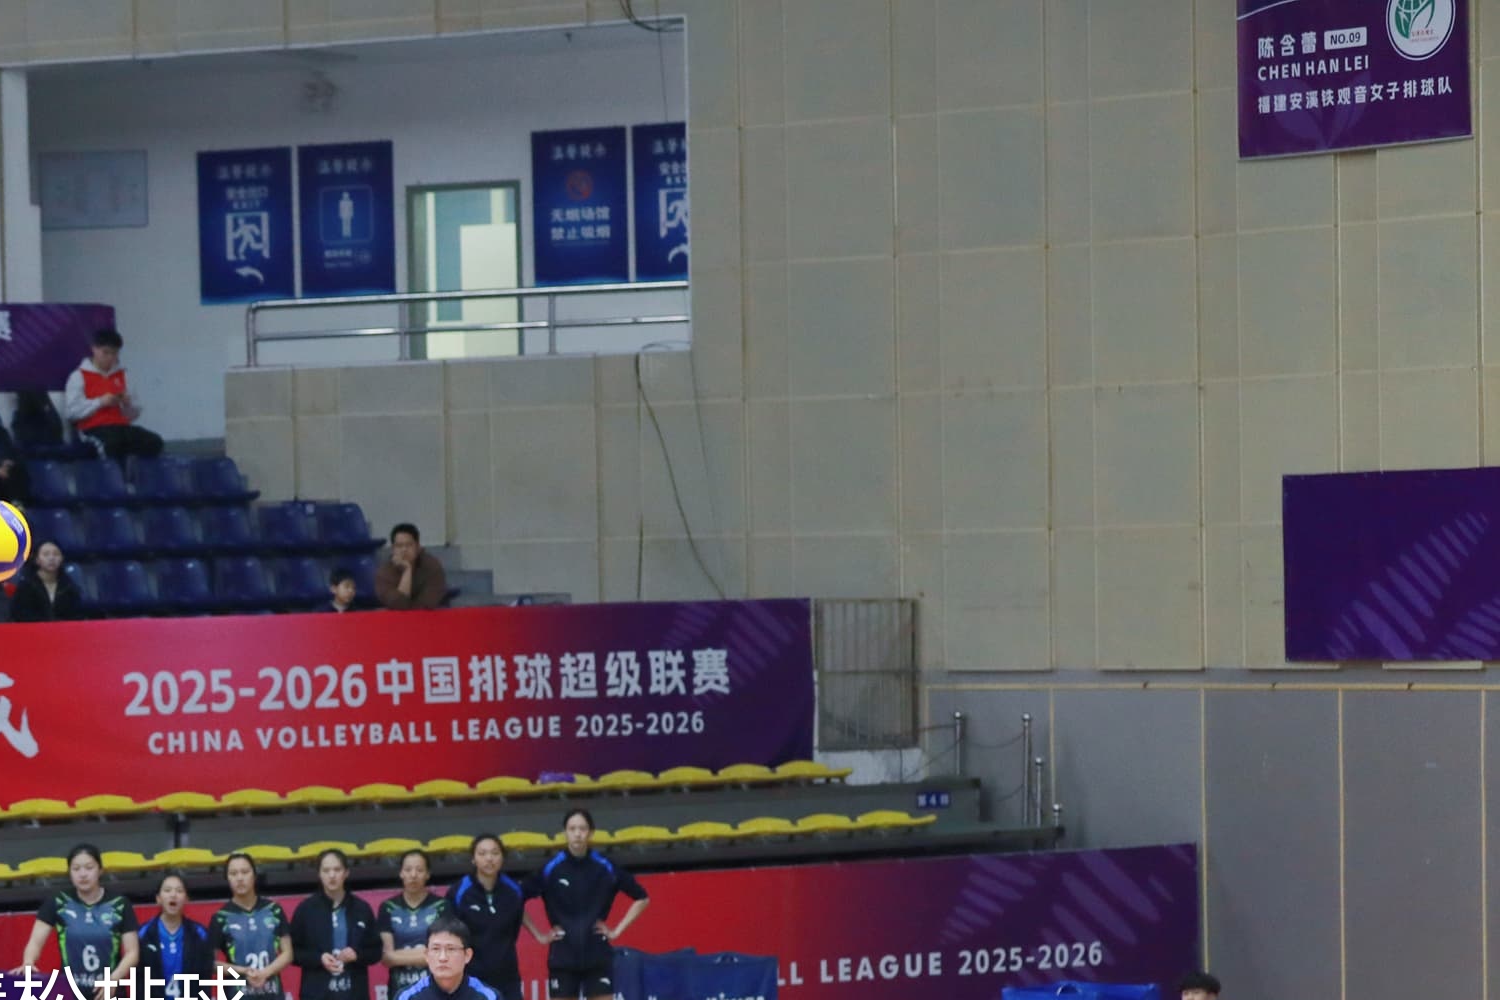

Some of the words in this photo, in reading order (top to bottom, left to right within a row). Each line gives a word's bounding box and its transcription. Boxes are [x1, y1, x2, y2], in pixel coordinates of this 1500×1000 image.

[1258, 31, 1317, 59] 陈含蕾
[1329, 32, 1362, 46] NO.09
[1258, 63, 1301, 81] CHEN
[1305, 59, 1340, 76] HAN
[1344, 55, 1370, 72] LEI
[551, 206, 611, 223] 无烟场馆
[551, 225, 611, 240] 禁止吸烟
[148, 730, 244, 755] CHINA
[256, 719, 438, 751] VOLLEYBALL
[452, 715, 562, 743] LEAGUE
[575, 711, 705, 739] 2025-2026
[82, 944, 100, 972] 6
[820, 952, 942, 983] LEAGUE
[958, 941, 1103, 975] 2025-2026
